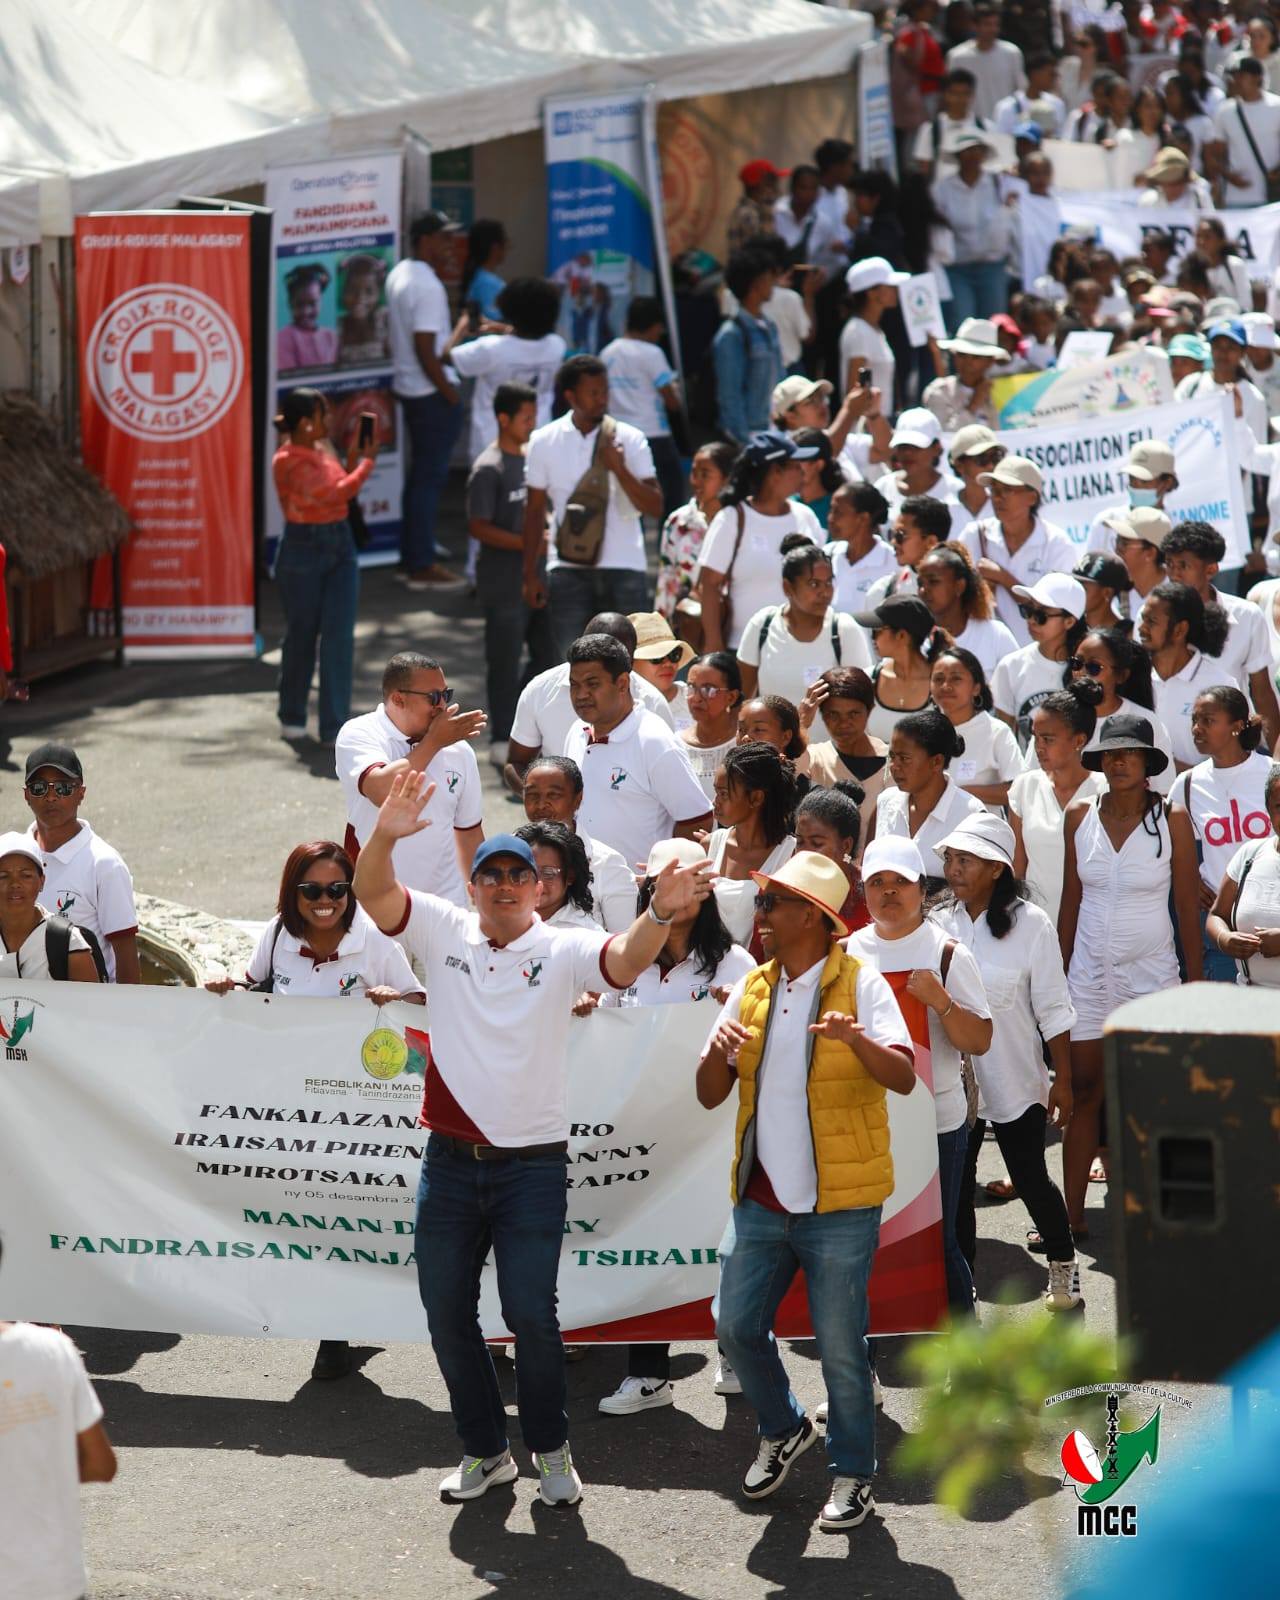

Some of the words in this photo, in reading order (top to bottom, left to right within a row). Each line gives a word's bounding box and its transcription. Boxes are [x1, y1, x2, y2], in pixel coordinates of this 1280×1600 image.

[81, 234, 168, 250] CROIX-ROUGE
[170, 233, 244, 249] MALAGASY
[102, 299, 228, 365] CROIX-ROUGE
[110, 386, 218, 427] MALAGASY
[1064, 471, 1115, 502] LIANA
[1204, 798, 1271, 847] alo
[304, 1078, 388, 1091] REPOBLIKAN'I
[391, 1083, 426, 1093] MAD
[358, 1088, 422, 1101] Tanindrazana
[200, 1103, 423, 1131] FANKALAZAN
[196, 1162, 409, 1188] MPIROTSAKA
[284, 1189, 301, 1200] ny
[304, 1190, 325, 1200] 05
[328, 1191, 399, 1204] desambra
